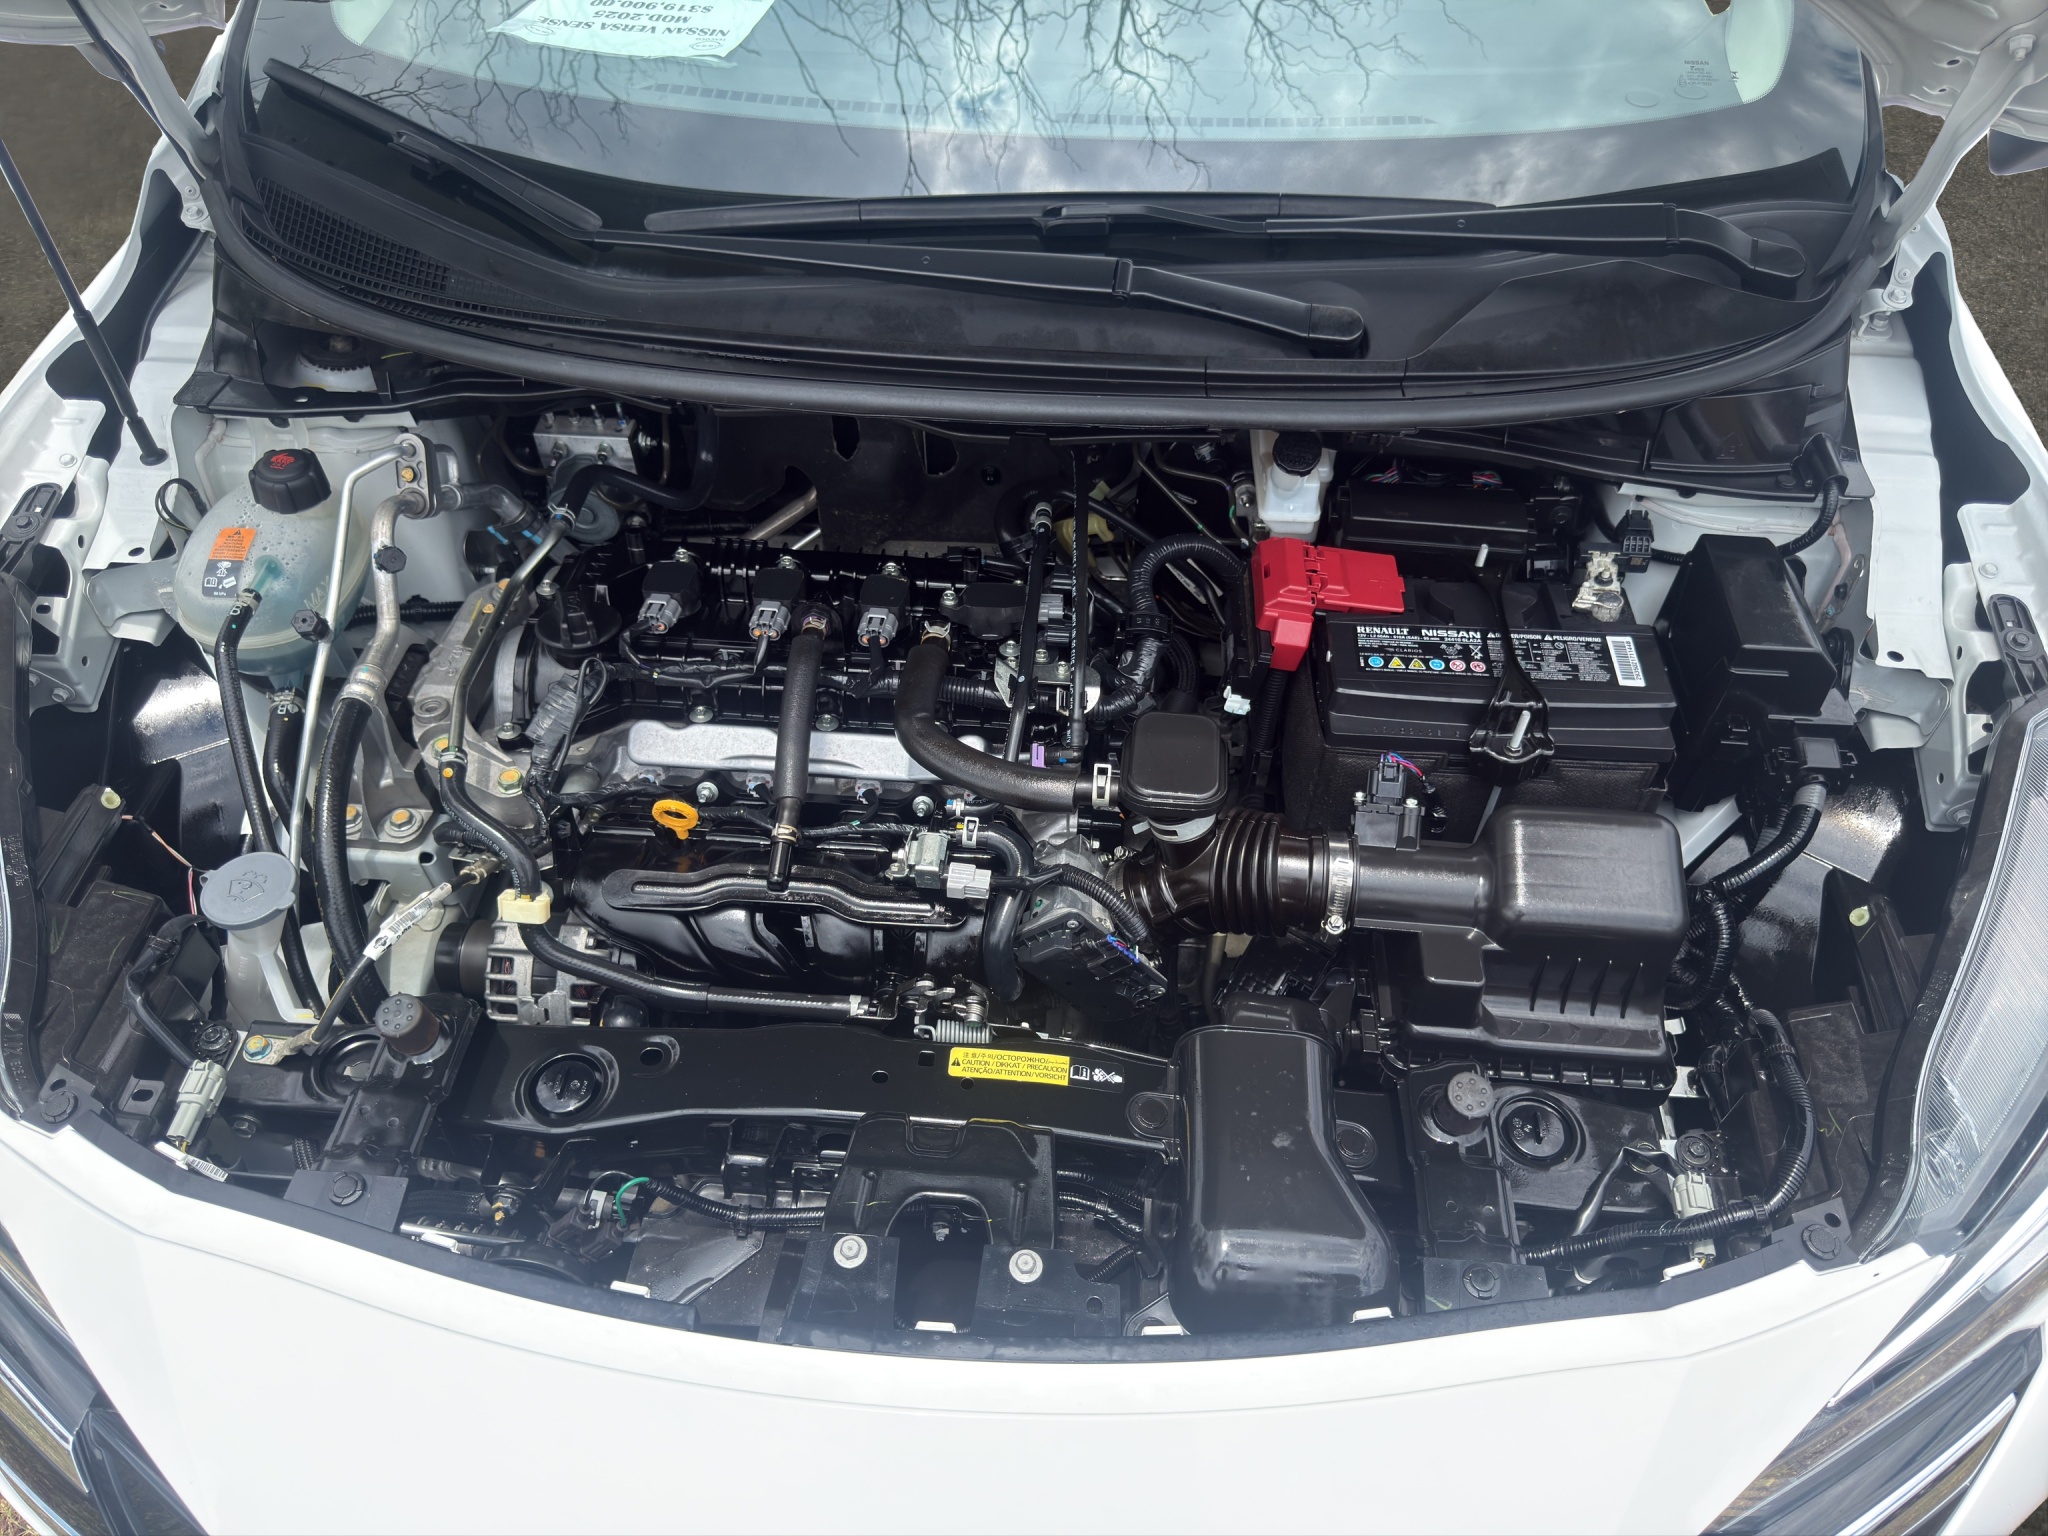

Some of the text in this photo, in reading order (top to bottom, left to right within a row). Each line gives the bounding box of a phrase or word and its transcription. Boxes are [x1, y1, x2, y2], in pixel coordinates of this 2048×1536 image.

[592, 10, 692, 24] MOD.2025
[538, 16, 730, 37] NISSAN VERSA SENSE
[1356, 626, 1481, 639] RENAULT NISSAN
[1552, 635, 1602, 643] PELIGRO/VENENO
[962, 1059, 990, 1067] CAUTION
[996, 1061, 1021, 1069] DIKKAT
